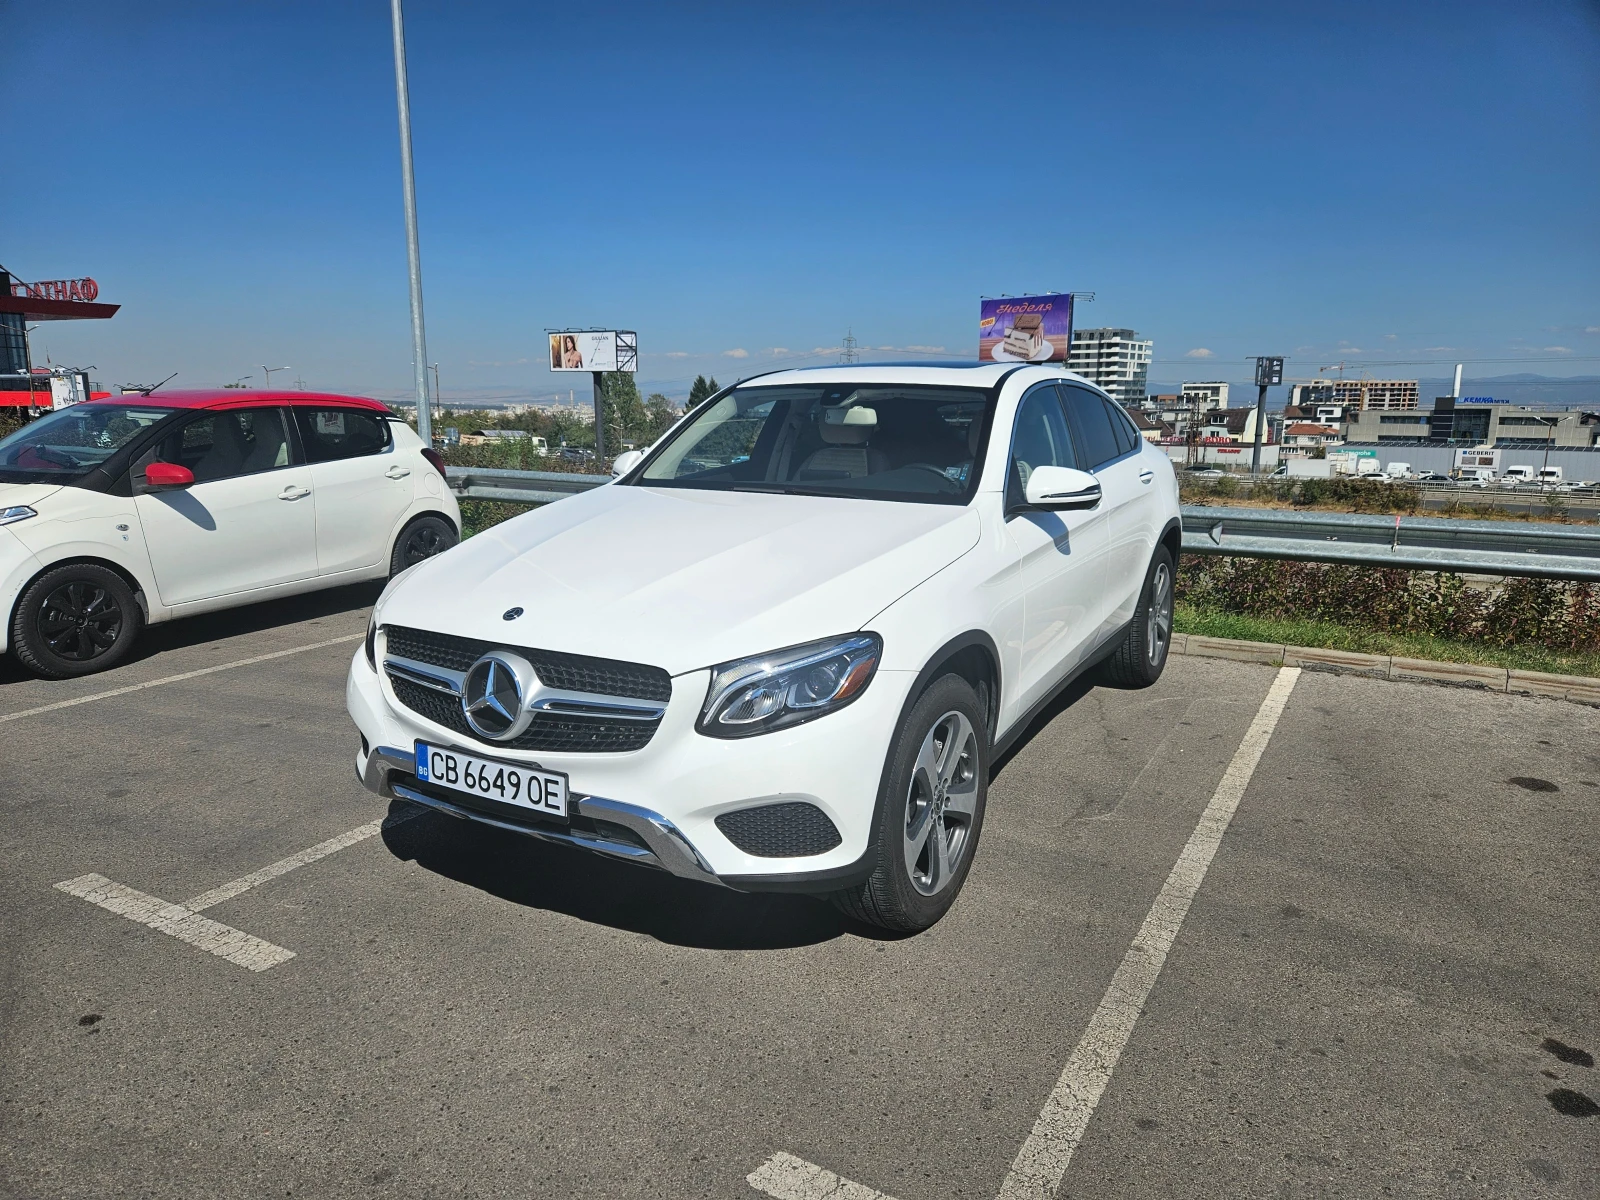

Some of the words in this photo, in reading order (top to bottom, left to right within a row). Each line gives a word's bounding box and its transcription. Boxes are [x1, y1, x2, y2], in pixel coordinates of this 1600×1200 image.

[418, 765, 428, 776] BG
[431, 751, 459, 784] CB
[464, 760, 521, 800] 6649
[527, 775, 560, 811] OE
